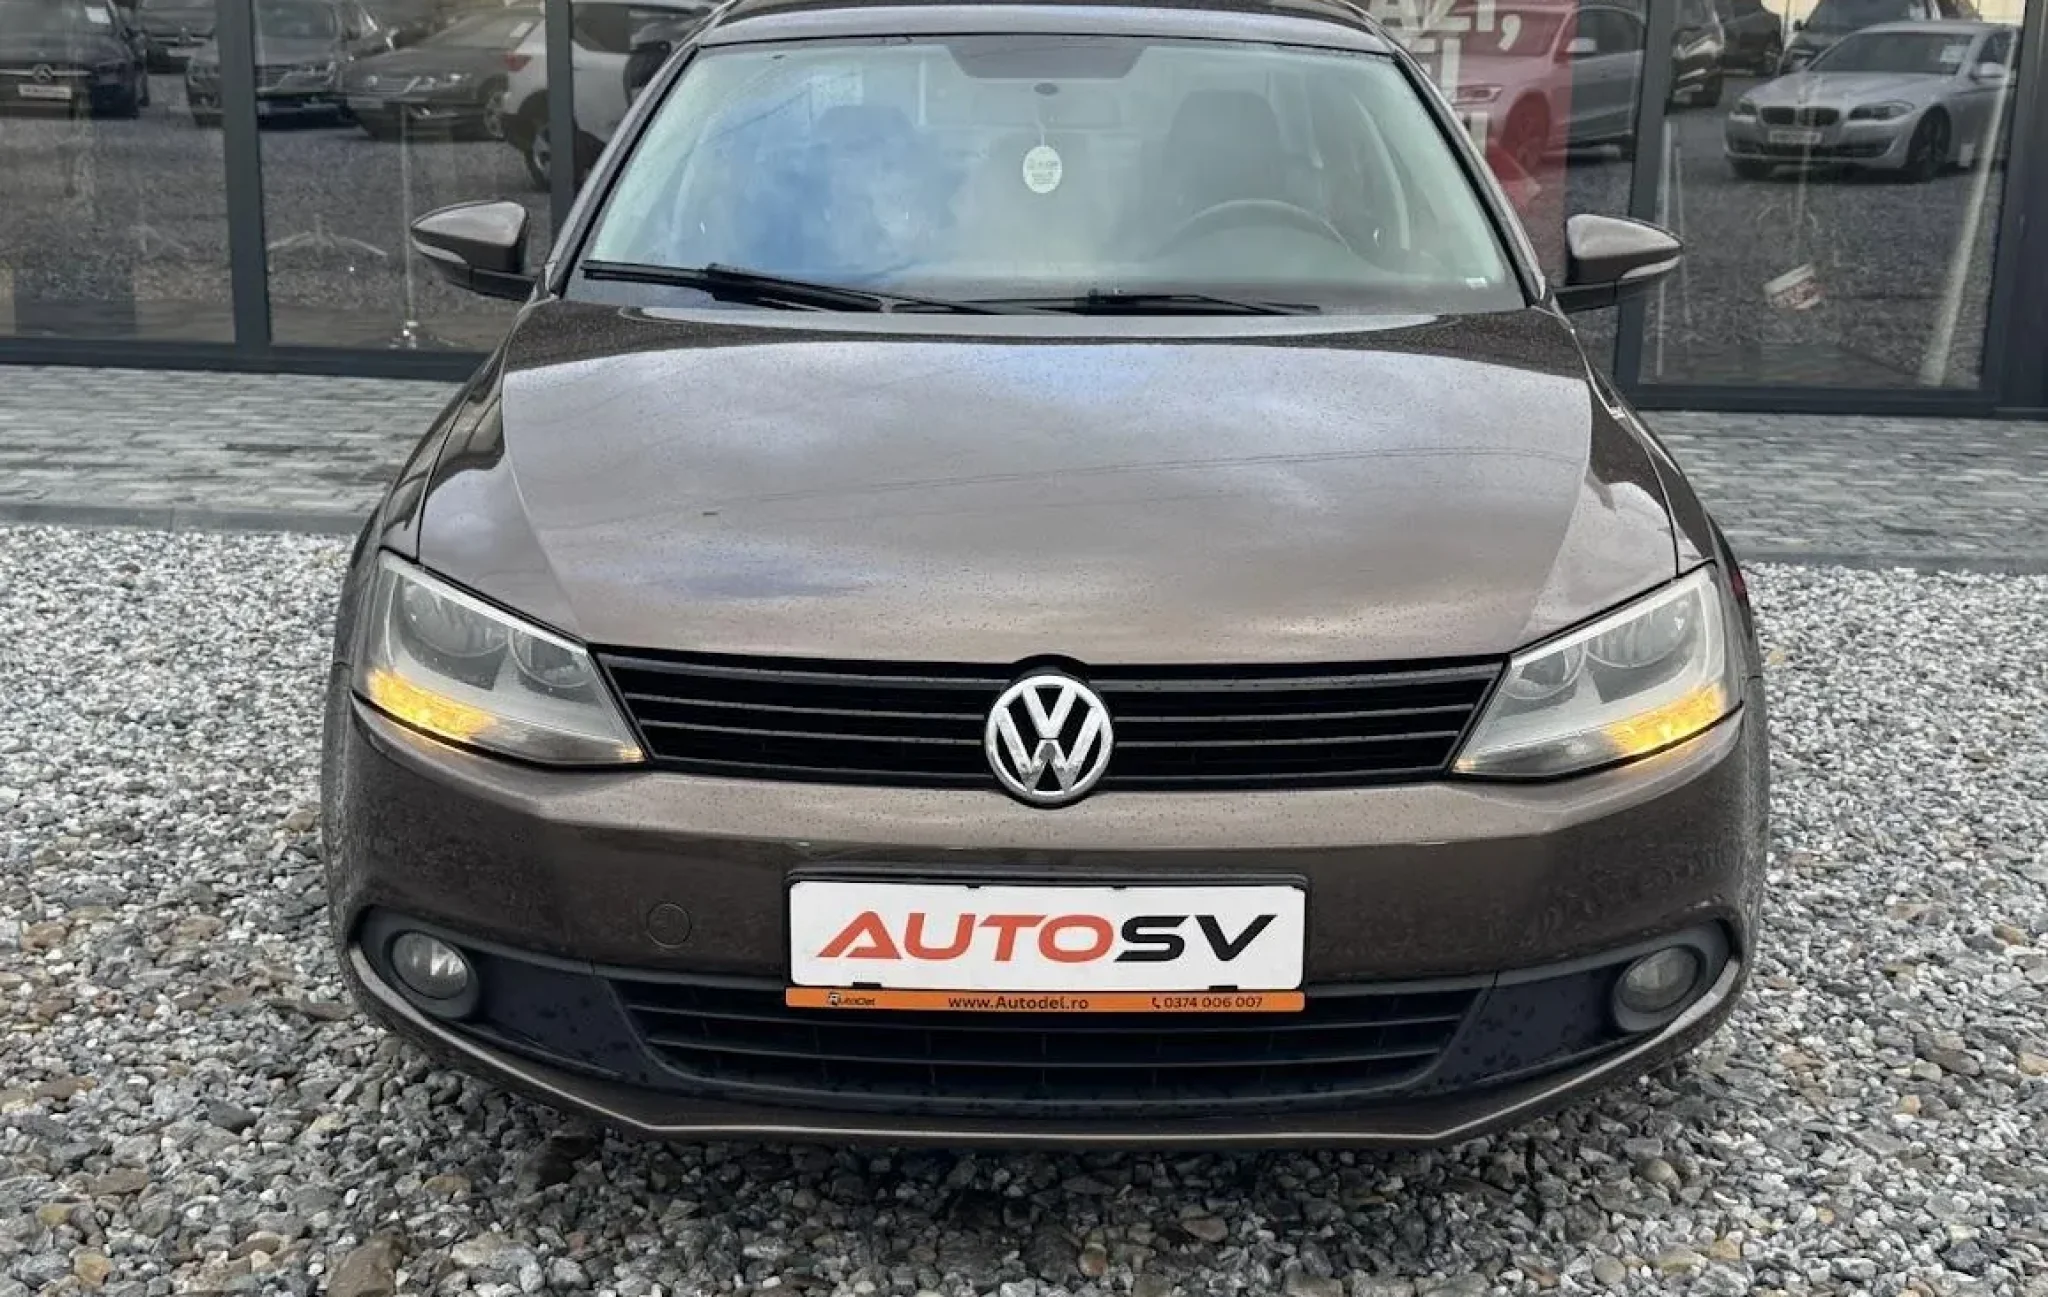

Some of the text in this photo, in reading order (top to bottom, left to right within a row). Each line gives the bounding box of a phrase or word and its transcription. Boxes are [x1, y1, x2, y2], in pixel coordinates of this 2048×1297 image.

[817, 911, 1278, 963] AUTOSV
[949, 996, 1089, 1010] www.Autodel.ro
[1164, 996, 1263, 1009] 0374 006 007
